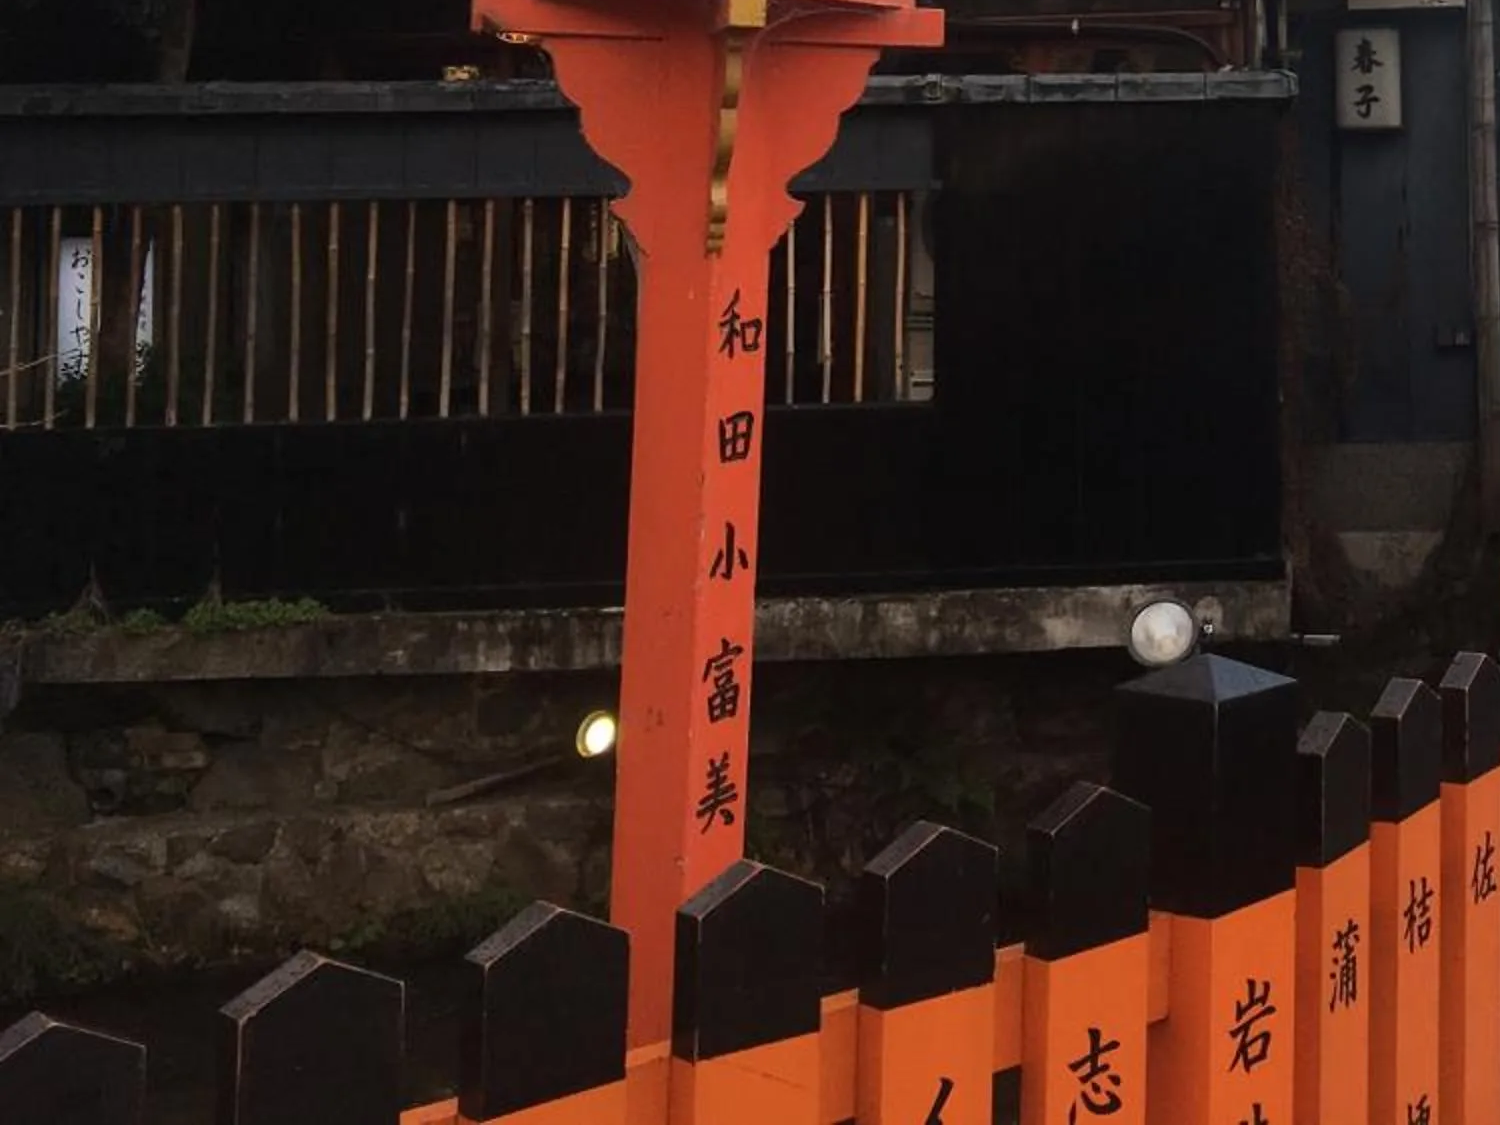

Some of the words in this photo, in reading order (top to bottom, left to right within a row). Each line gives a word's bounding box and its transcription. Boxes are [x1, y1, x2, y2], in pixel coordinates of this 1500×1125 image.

[1351, 37, 1384, 121] 春子
[695, 288, 764, 835] 和田小富美
[1470, 830, 1499, 906] 佐
